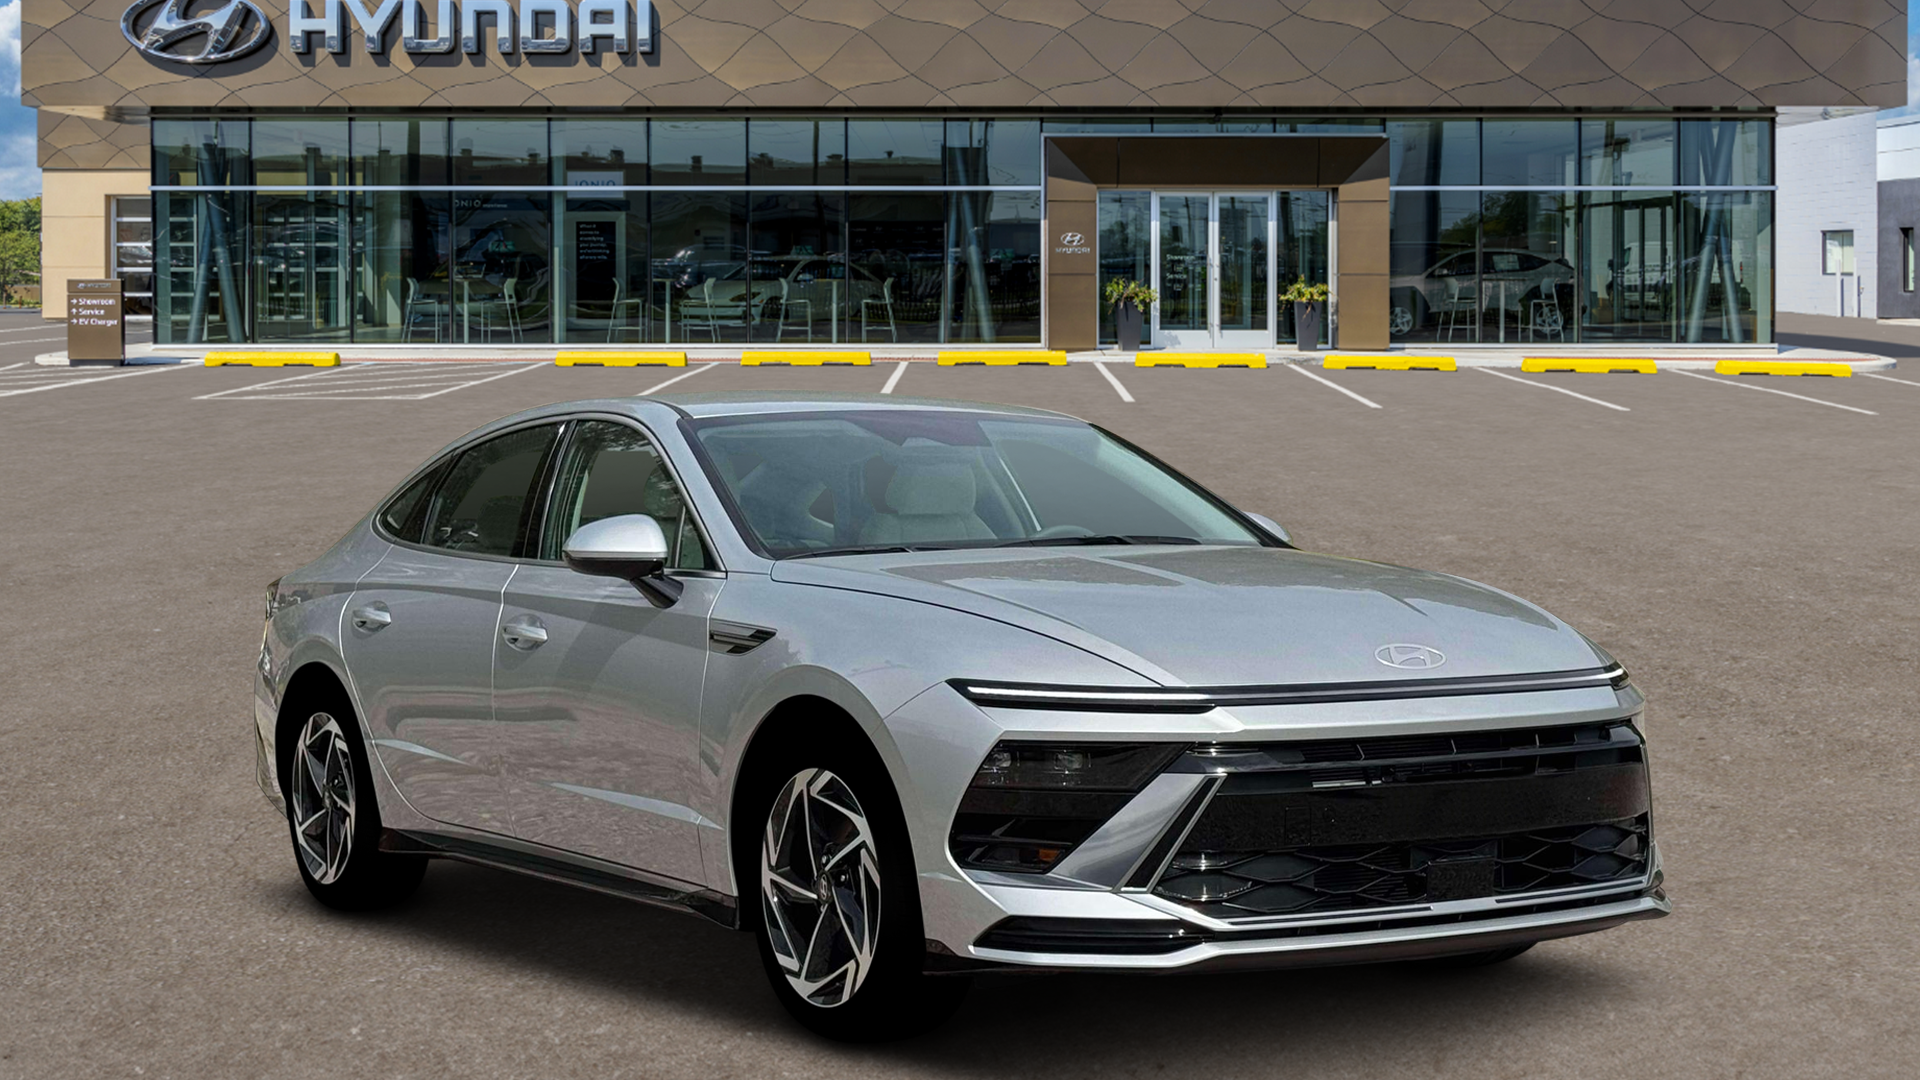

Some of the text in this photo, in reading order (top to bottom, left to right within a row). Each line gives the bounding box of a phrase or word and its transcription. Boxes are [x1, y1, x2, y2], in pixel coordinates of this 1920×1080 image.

[289, 0, 654, 53] HYUNDAI
[79, 307, 105, 315] Service
[90, 318, 118, 327] Charger
